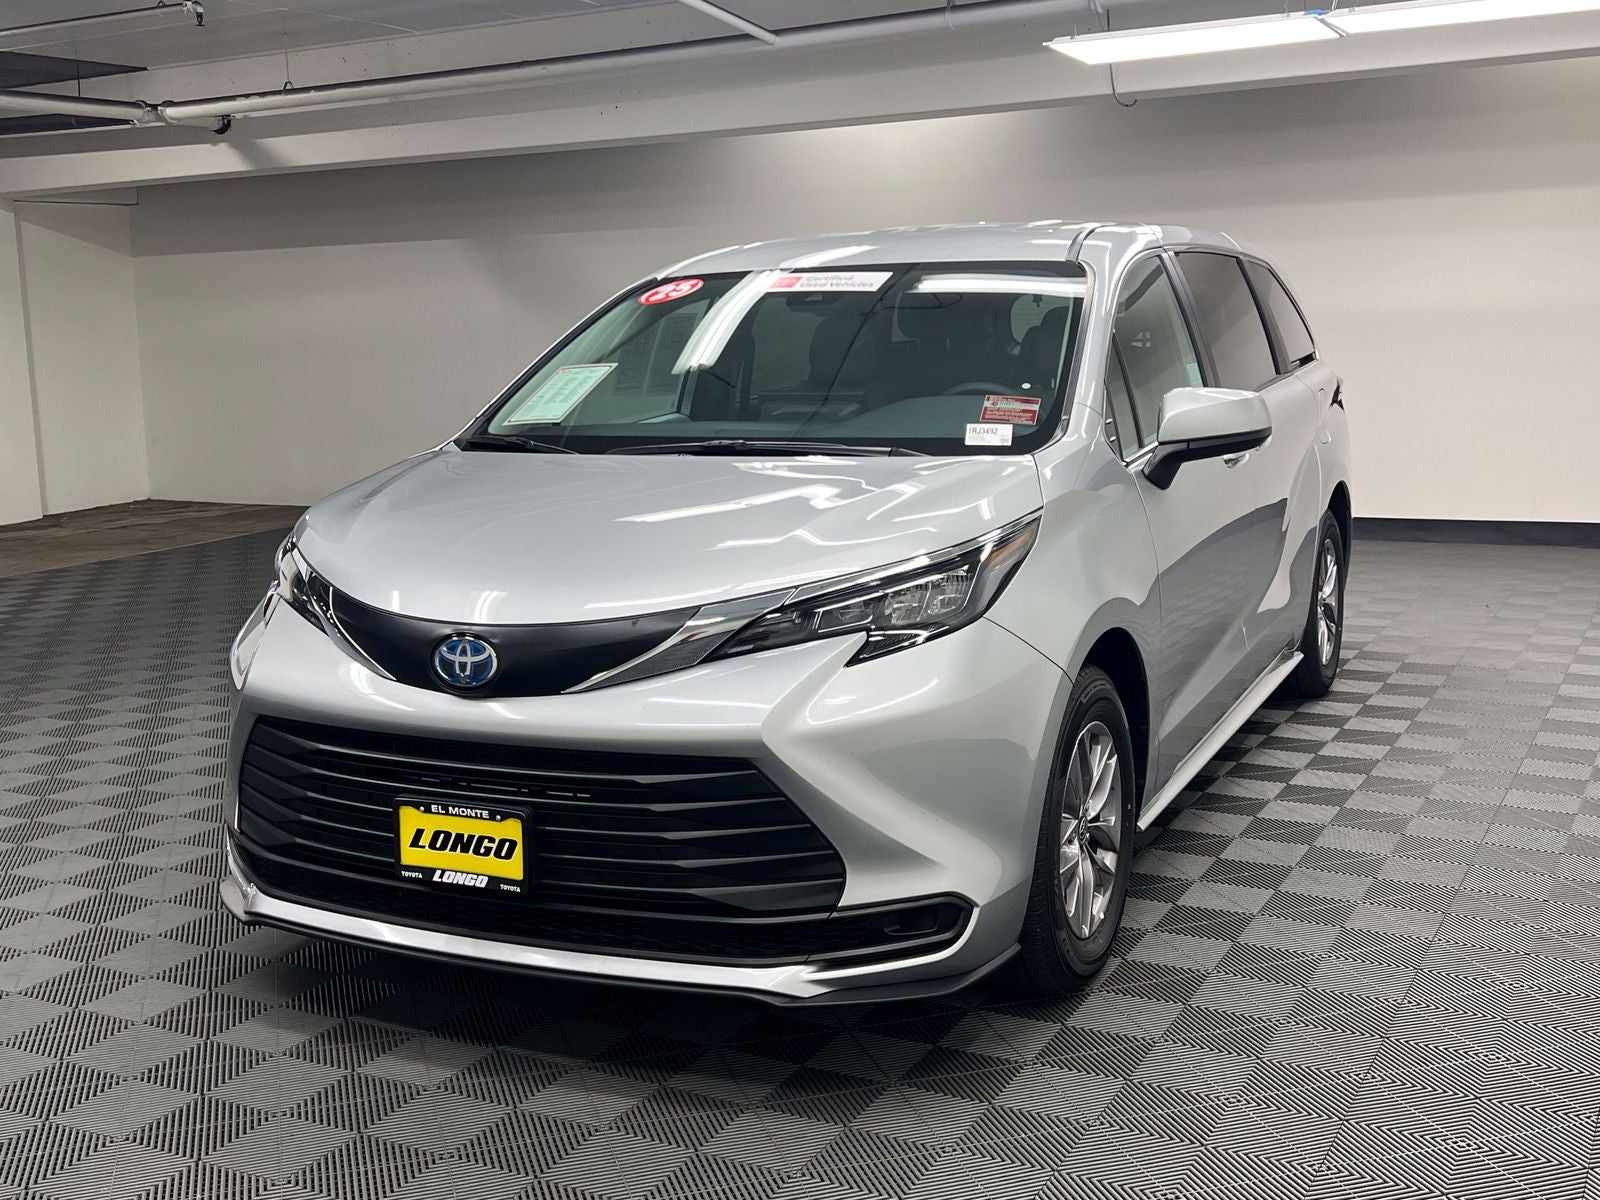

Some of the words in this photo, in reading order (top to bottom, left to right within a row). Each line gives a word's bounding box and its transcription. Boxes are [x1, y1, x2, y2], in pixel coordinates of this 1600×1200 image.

[431, 804, 446, 814] EL
[448, 806, 490, 819] MONTE
[408, 828, 518, 860] LONGO
[401, 870, 423, 879] TOYOTA
[432, 869, 489, 888] LONGO
[500, 884, 521, 893] TOYOTA
